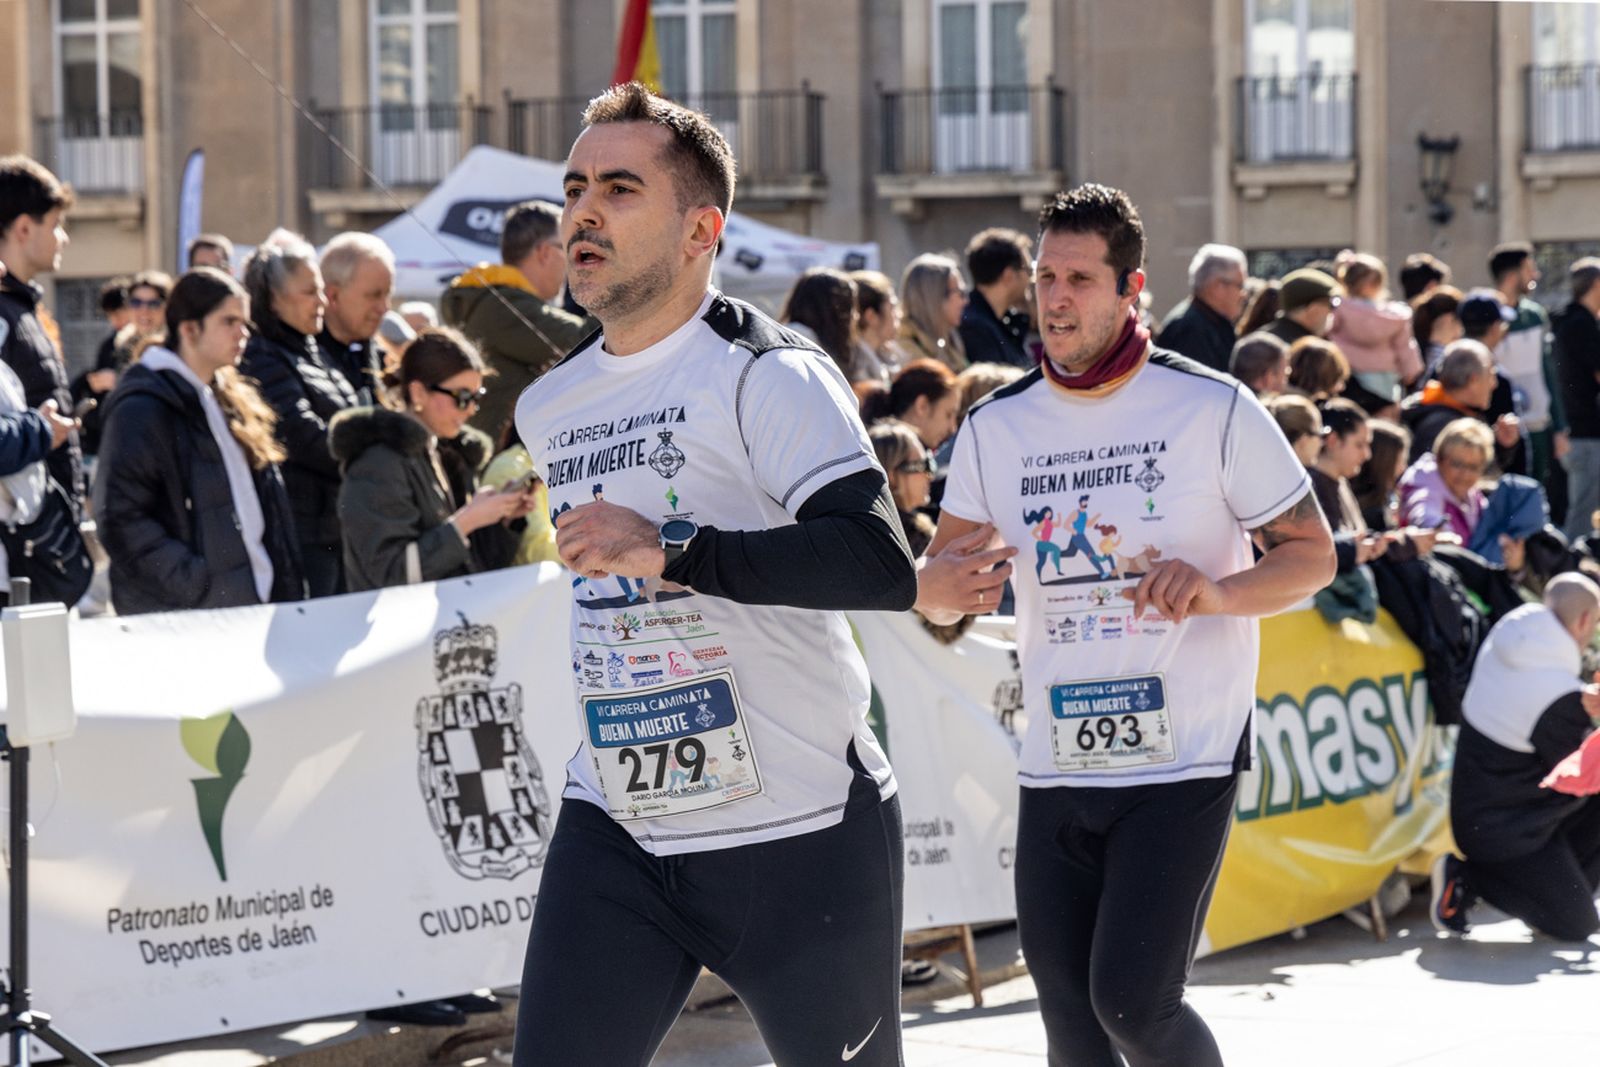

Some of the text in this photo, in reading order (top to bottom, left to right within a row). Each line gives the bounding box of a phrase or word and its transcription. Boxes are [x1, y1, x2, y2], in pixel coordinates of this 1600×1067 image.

[559, 421, 614, 448] CARRERA
[617, 406, 686, 434] CAMINATA
[547, 438, 646, 488] BUENA MUERTE
[1021, 440, 1167, 468] VI CARRERA CAMINATA
[1021, 464, 1133, 496] BUENA MUERTE
[603, 702, 648, 716] CARRERA
[649, 688, 712, 711] CAMINATA
[1062, 696, 1132, 715] BUENA MUERTE
[598, 712, 690, 742] BUENA MUERTE
[1076, 714, 1143, 752] 693
[618, 737, 706, 794] 279
[680, 783, 709, 797] MOLINA
[107, 884, 334, 934] Patronato Municipal de
[419, 894, 538, 937] CIUDAD D
[139, 920, 317, 967] Deportes de Jaén
